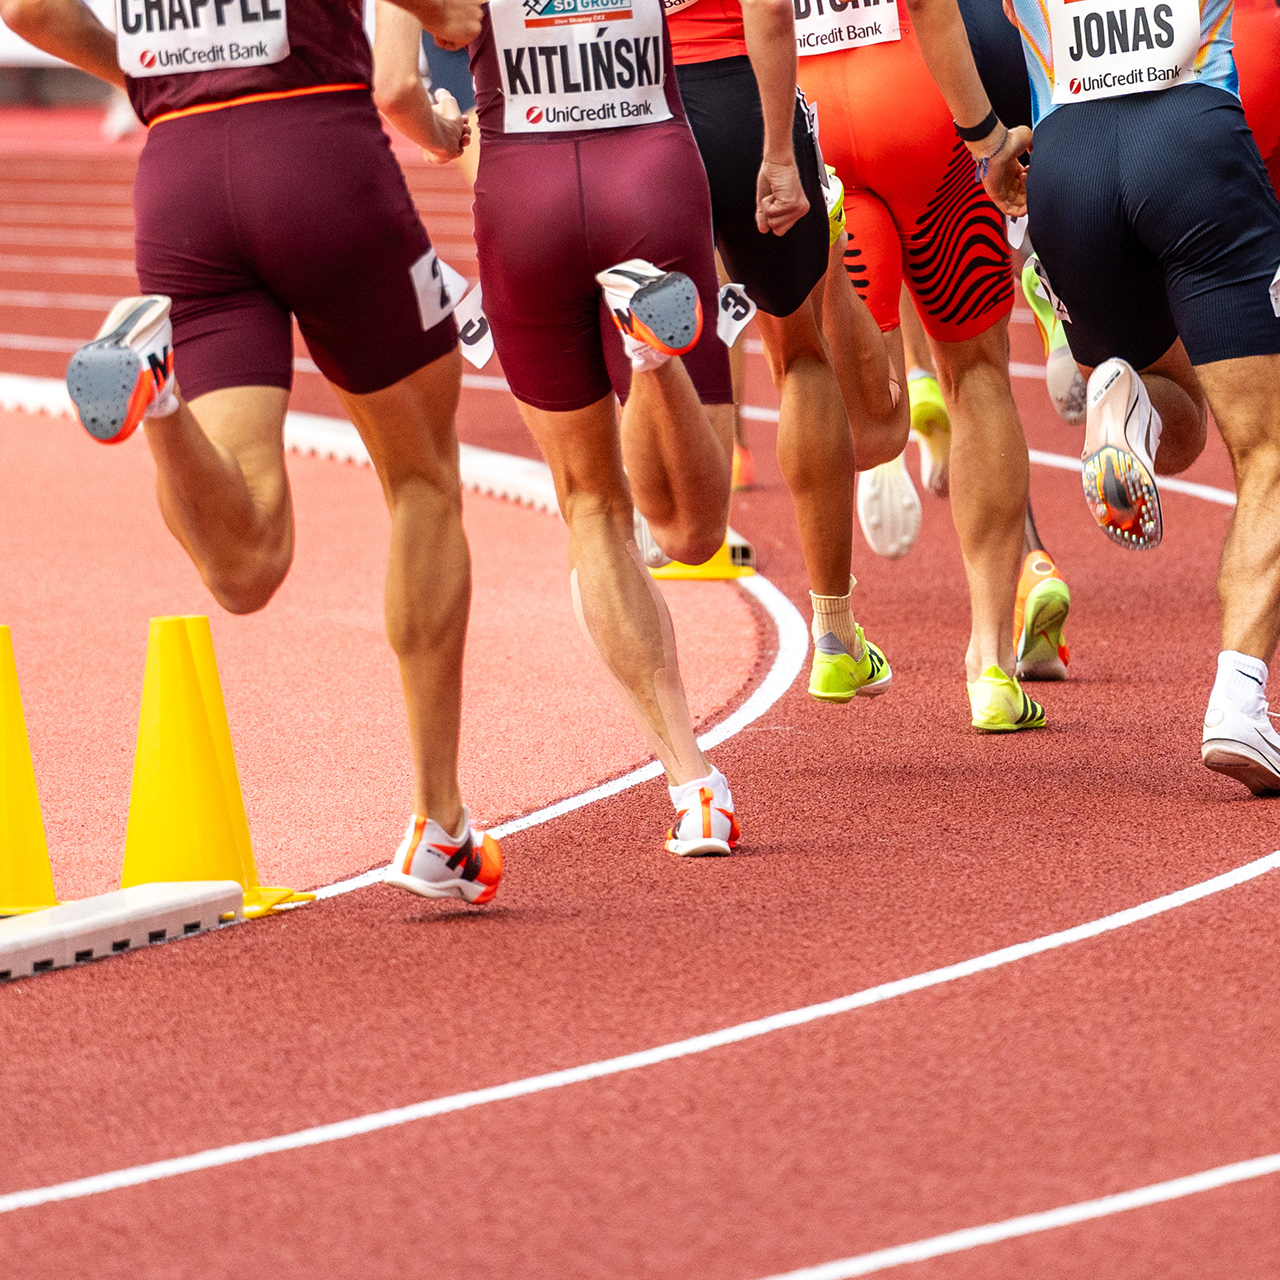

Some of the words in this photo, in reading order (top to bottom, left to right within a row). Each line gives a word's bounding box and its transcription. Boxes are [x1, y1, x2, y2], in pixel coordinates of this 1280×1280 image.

[795, 29, 844, 48] niCredit
[846, 22, 882, 40] Bank
[1068, 3, 1175, 62] JONAS
[158, 45, 225, 67] UniCredit
[229, 41, 269, 59] Bank
[503, 27, 660, 95] KITLIŃSKI
[1082, 70, 1144, 93] UniCredit
[1147, 65, 1182, 83] Bank
[546, 103, 617, 123] UniCredit
[621, 101, 653, 118] Bank
